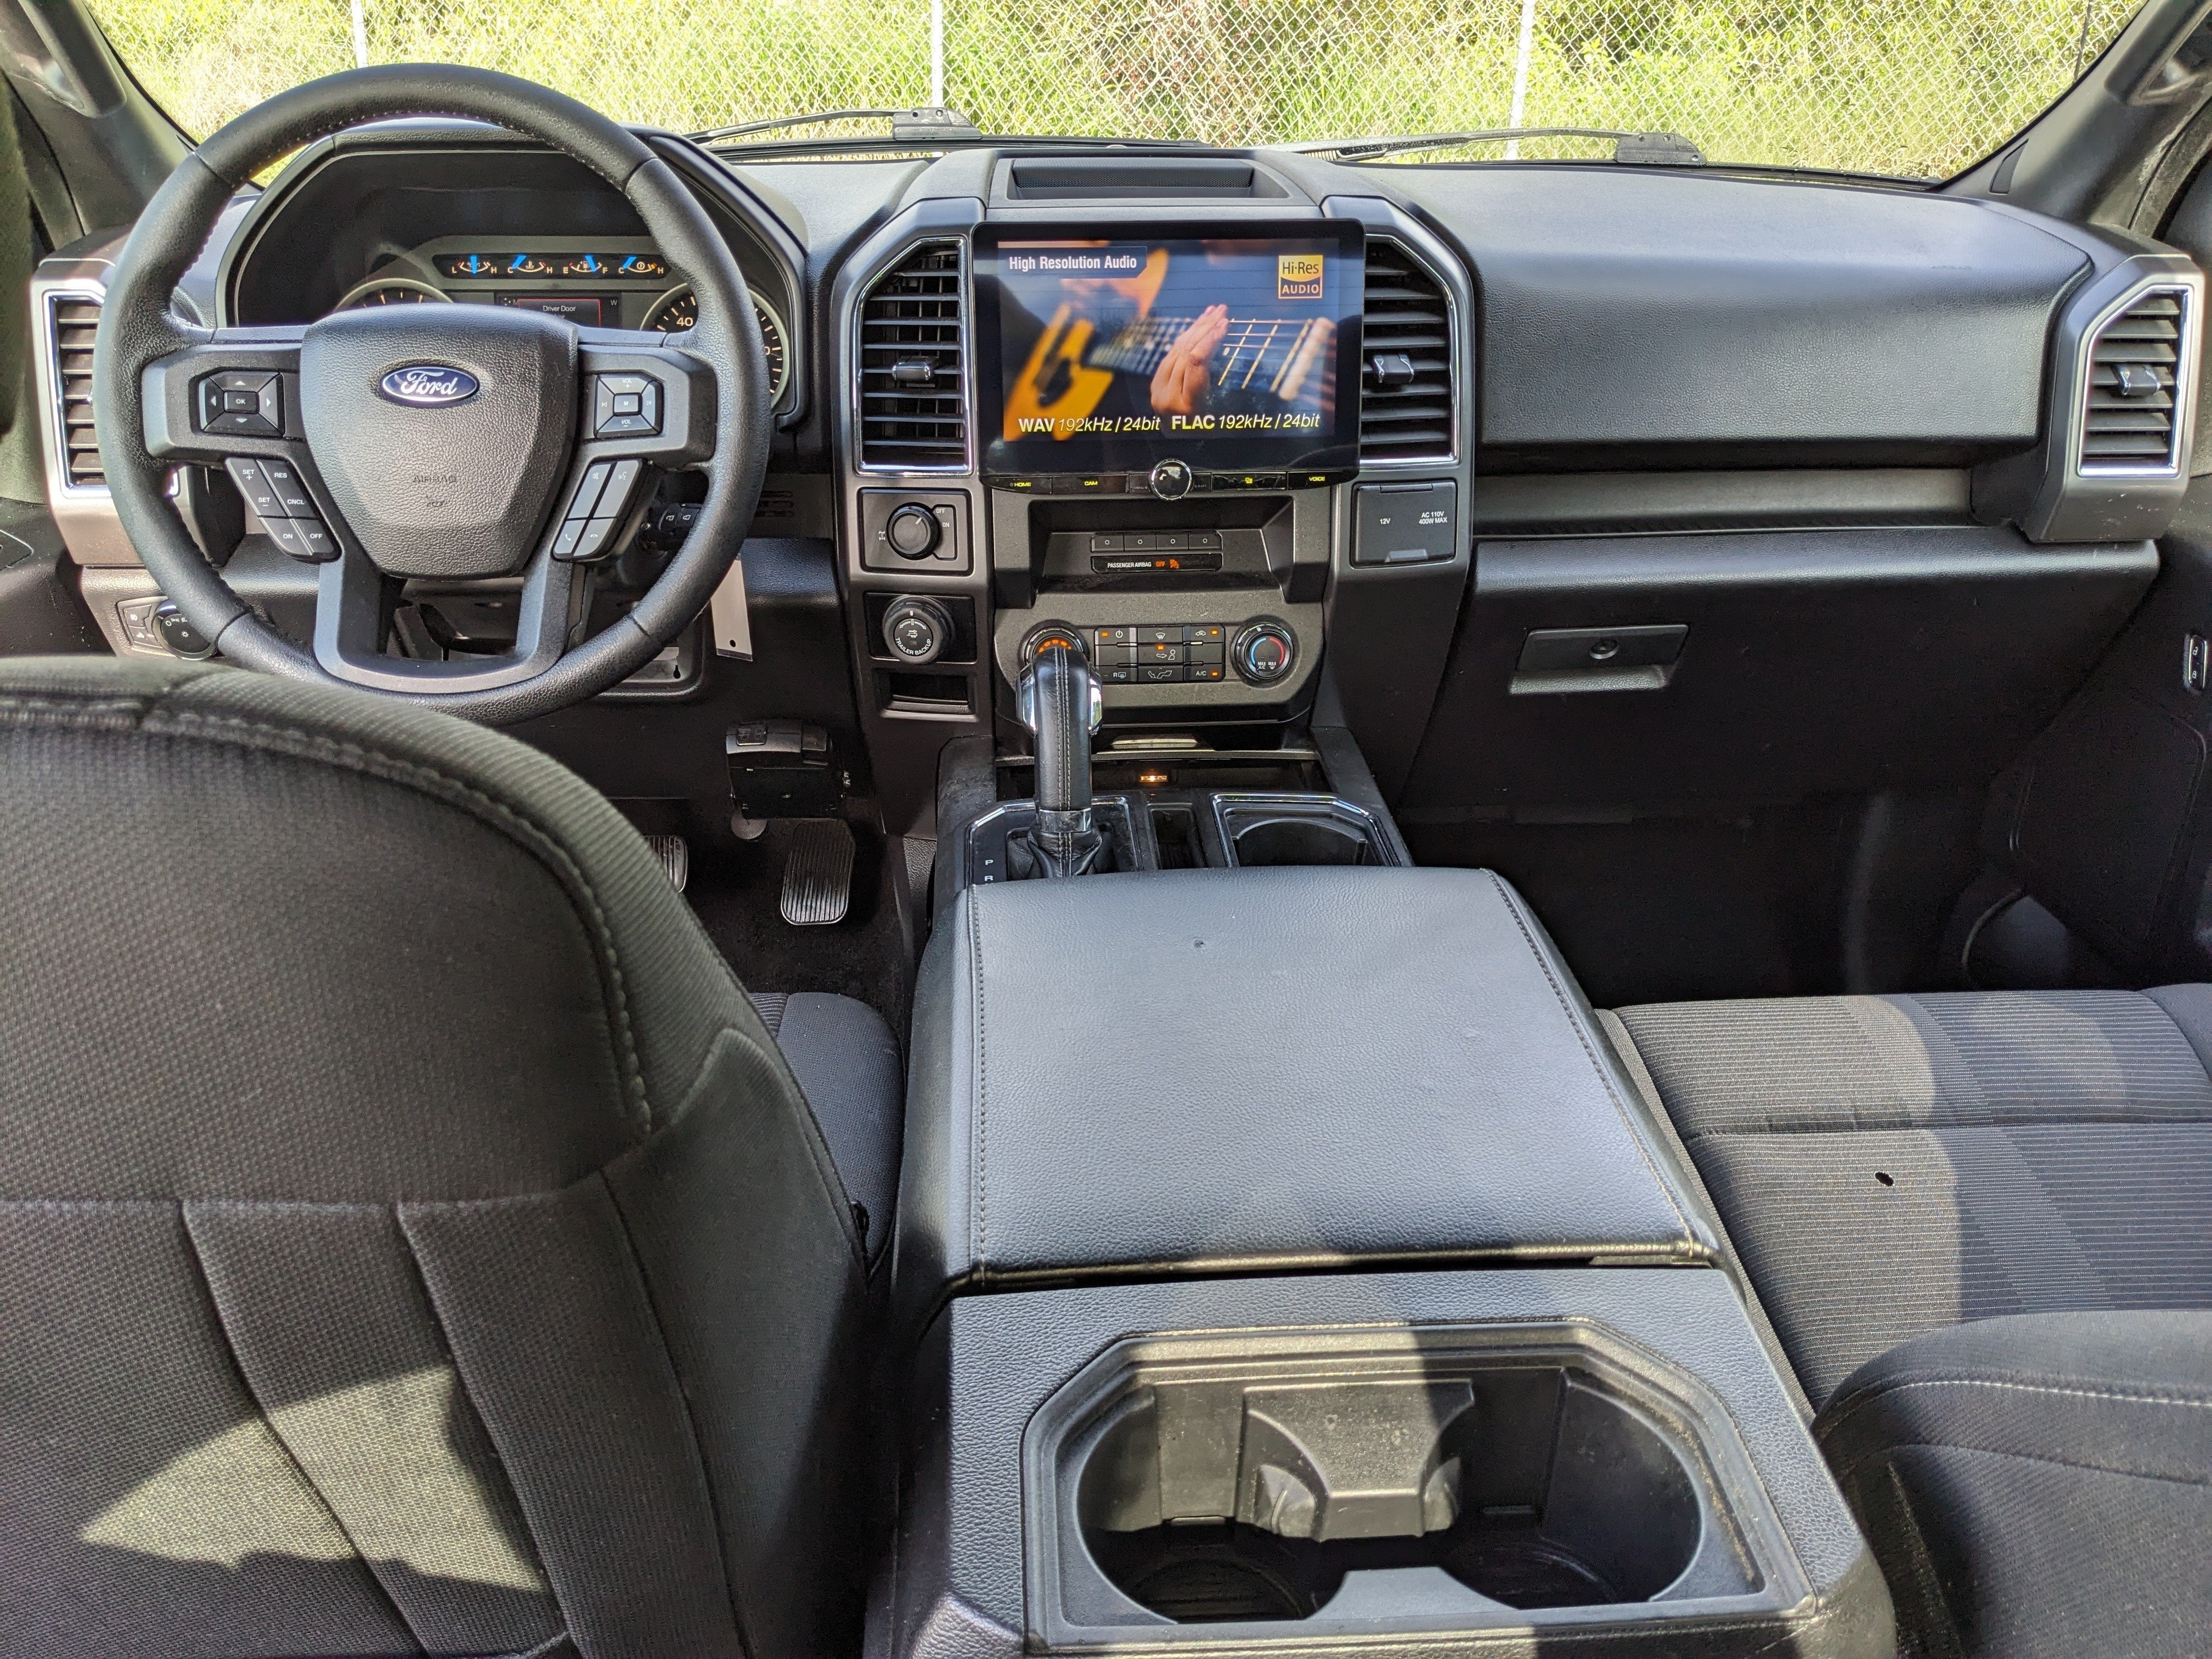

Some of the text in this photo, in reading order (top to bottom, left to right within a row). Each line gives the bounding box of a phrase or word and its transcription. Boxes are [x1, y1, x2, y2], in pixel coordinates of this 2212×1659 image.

[1009, 255, 1137, 272] High Resolution Audio
[1282, 284, 1319, 294] AUDIO
[676, 317, 693, 326] 40
[400, 370, 459, 395] Ford
[1018, 417, 1056, 432] WAV
[1059, 416, 1113, 432] 192kHz
[1123, 416, 1161, 431] 24bit
[1172, 415, 1215, 430] FLAC
[1218, 414, 1273, 429] 192kHz
[1283, 413, 1321, 428] 24bit
[895, 637, 932, 655] TRAILER BACKUP
